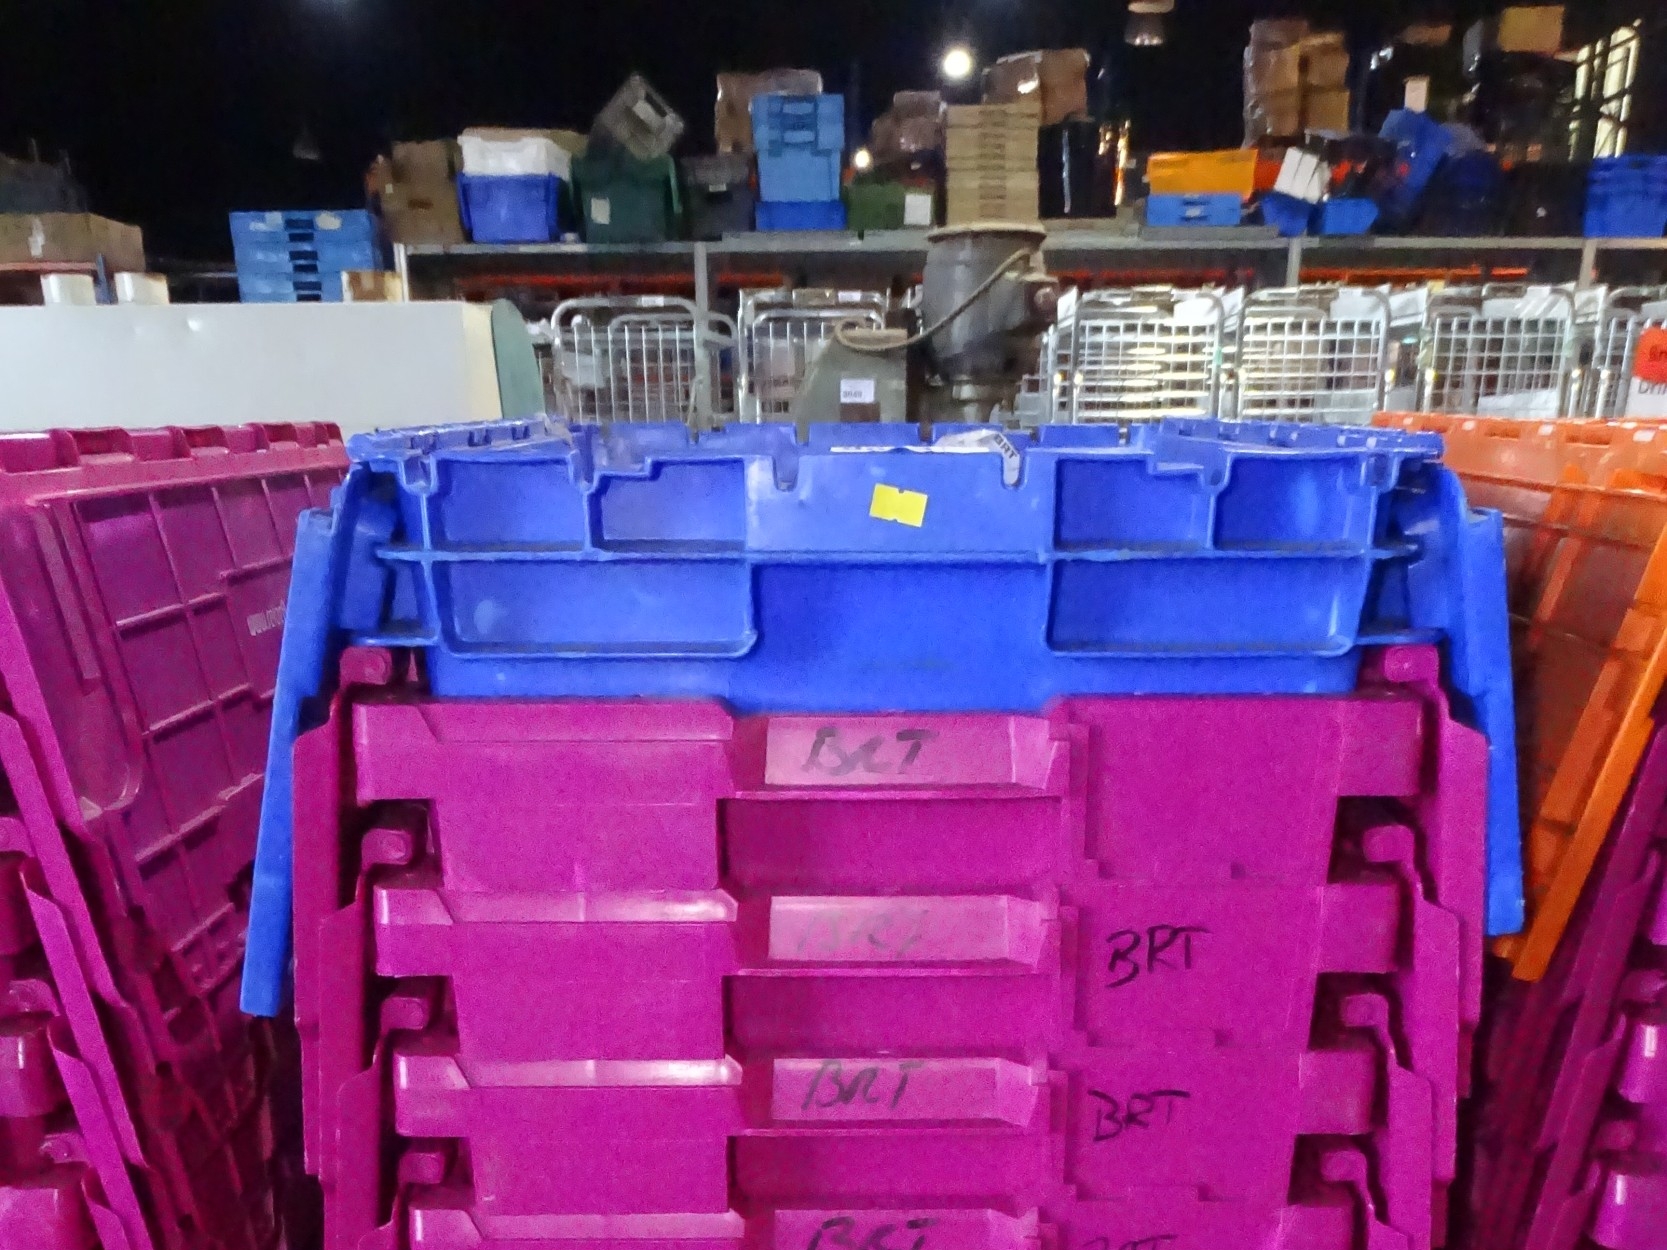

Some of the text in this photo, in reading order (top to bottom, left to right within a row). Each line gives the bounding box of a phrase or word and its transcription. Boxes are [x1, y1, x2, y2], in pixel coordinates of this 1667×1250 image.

[1106, 924, 1210, 988] BRT
[801, 1058, 925, 1110] BRT
[1088, 1089, 1190, 1142] BRT
